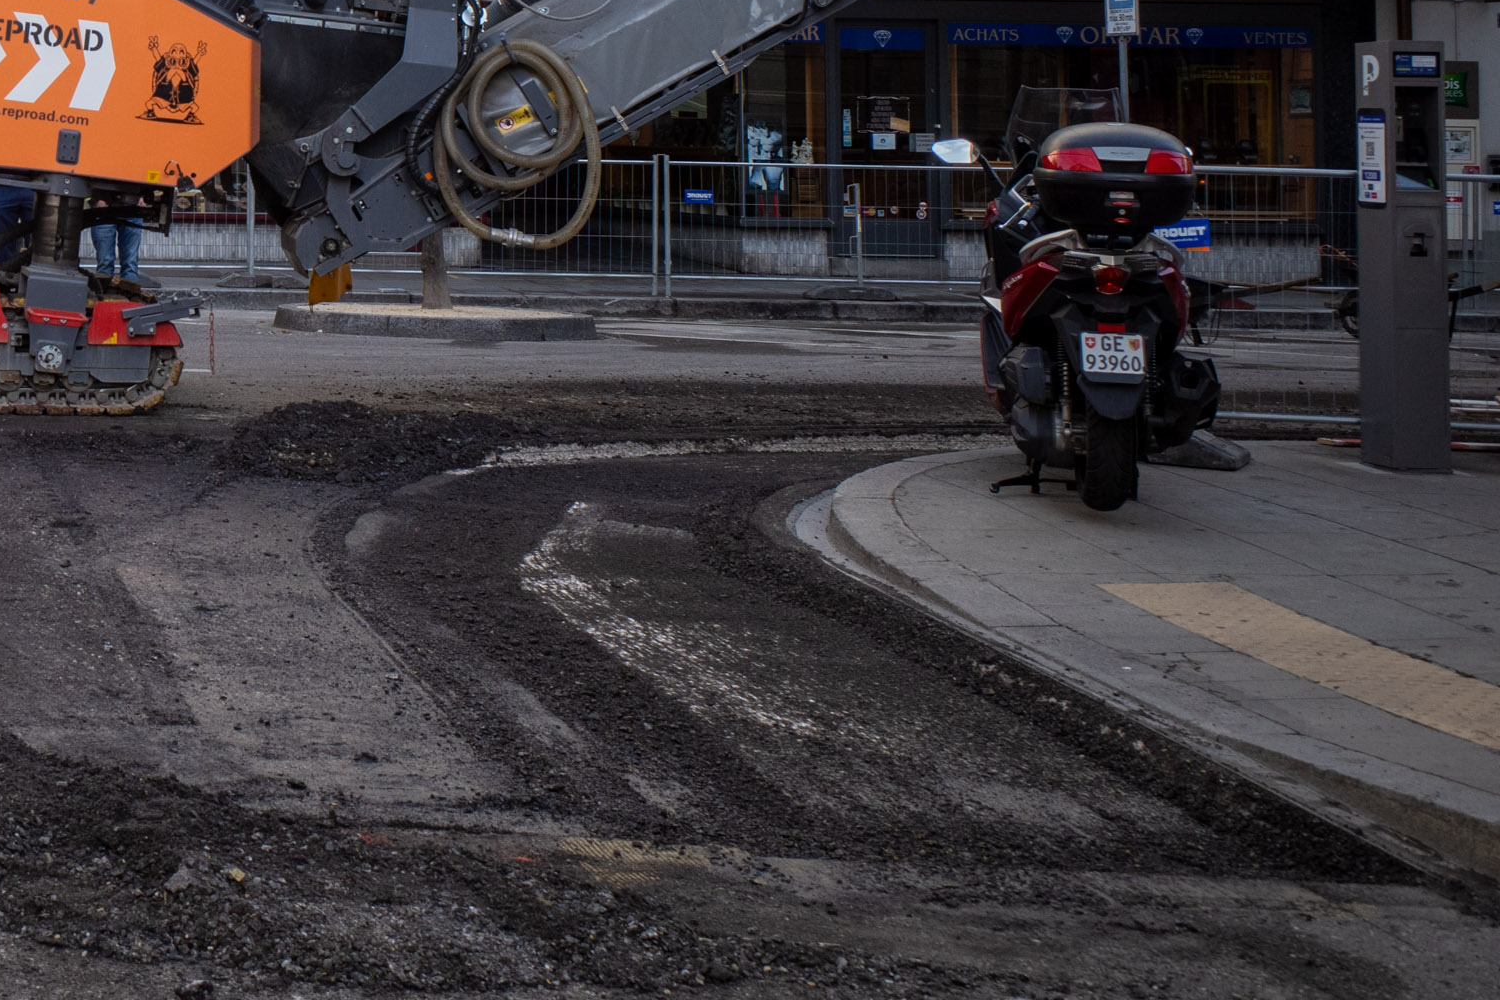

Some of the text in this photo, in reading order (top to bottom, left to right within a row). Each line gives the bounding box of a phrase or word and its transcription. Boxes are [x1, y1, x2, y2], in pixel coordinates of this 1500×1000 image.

[953, 28, 1020, 42] ACHATS
[1243, 31, 1308, 45] VENTES
[1362, 54, 1379, 96] P
[1101, 336, 1125, 352] GE
[1086, 354, 1141, 372] 93960
